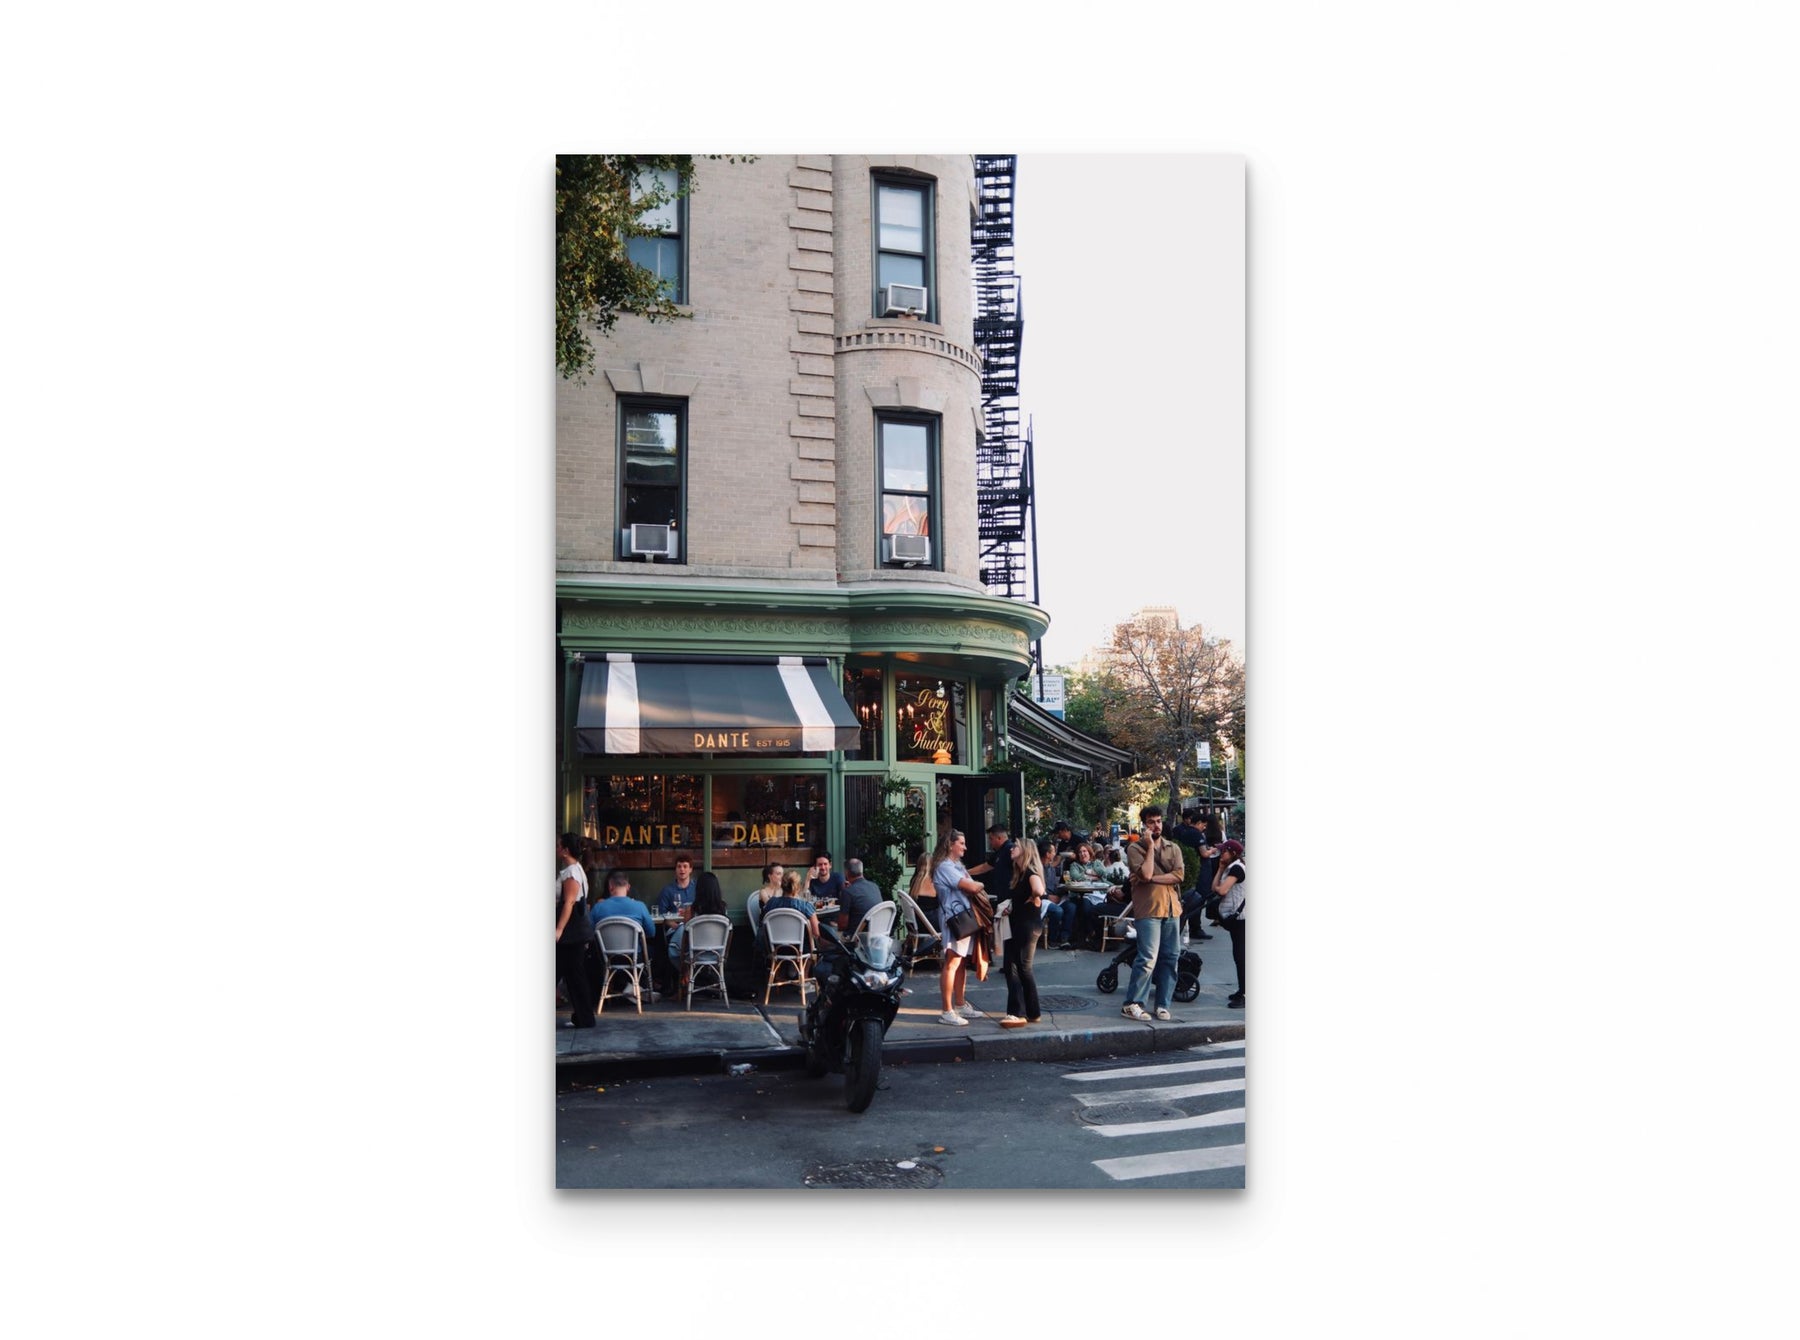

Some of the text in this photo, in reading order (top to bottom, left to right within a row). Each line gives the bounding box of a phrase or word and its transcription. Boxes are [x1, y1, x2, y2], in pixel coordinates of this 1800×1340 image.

[914, 688, 949, 720] Perry
[924, 712, 943, 734] &
[694, 732, 750, 748] DANTE
[756, 739, 772, 747] EST
[908, 730, 954, 751] Hudson
[605, 824, 681, 845] DANTE
[733, 822, 806, 844] DANTE
